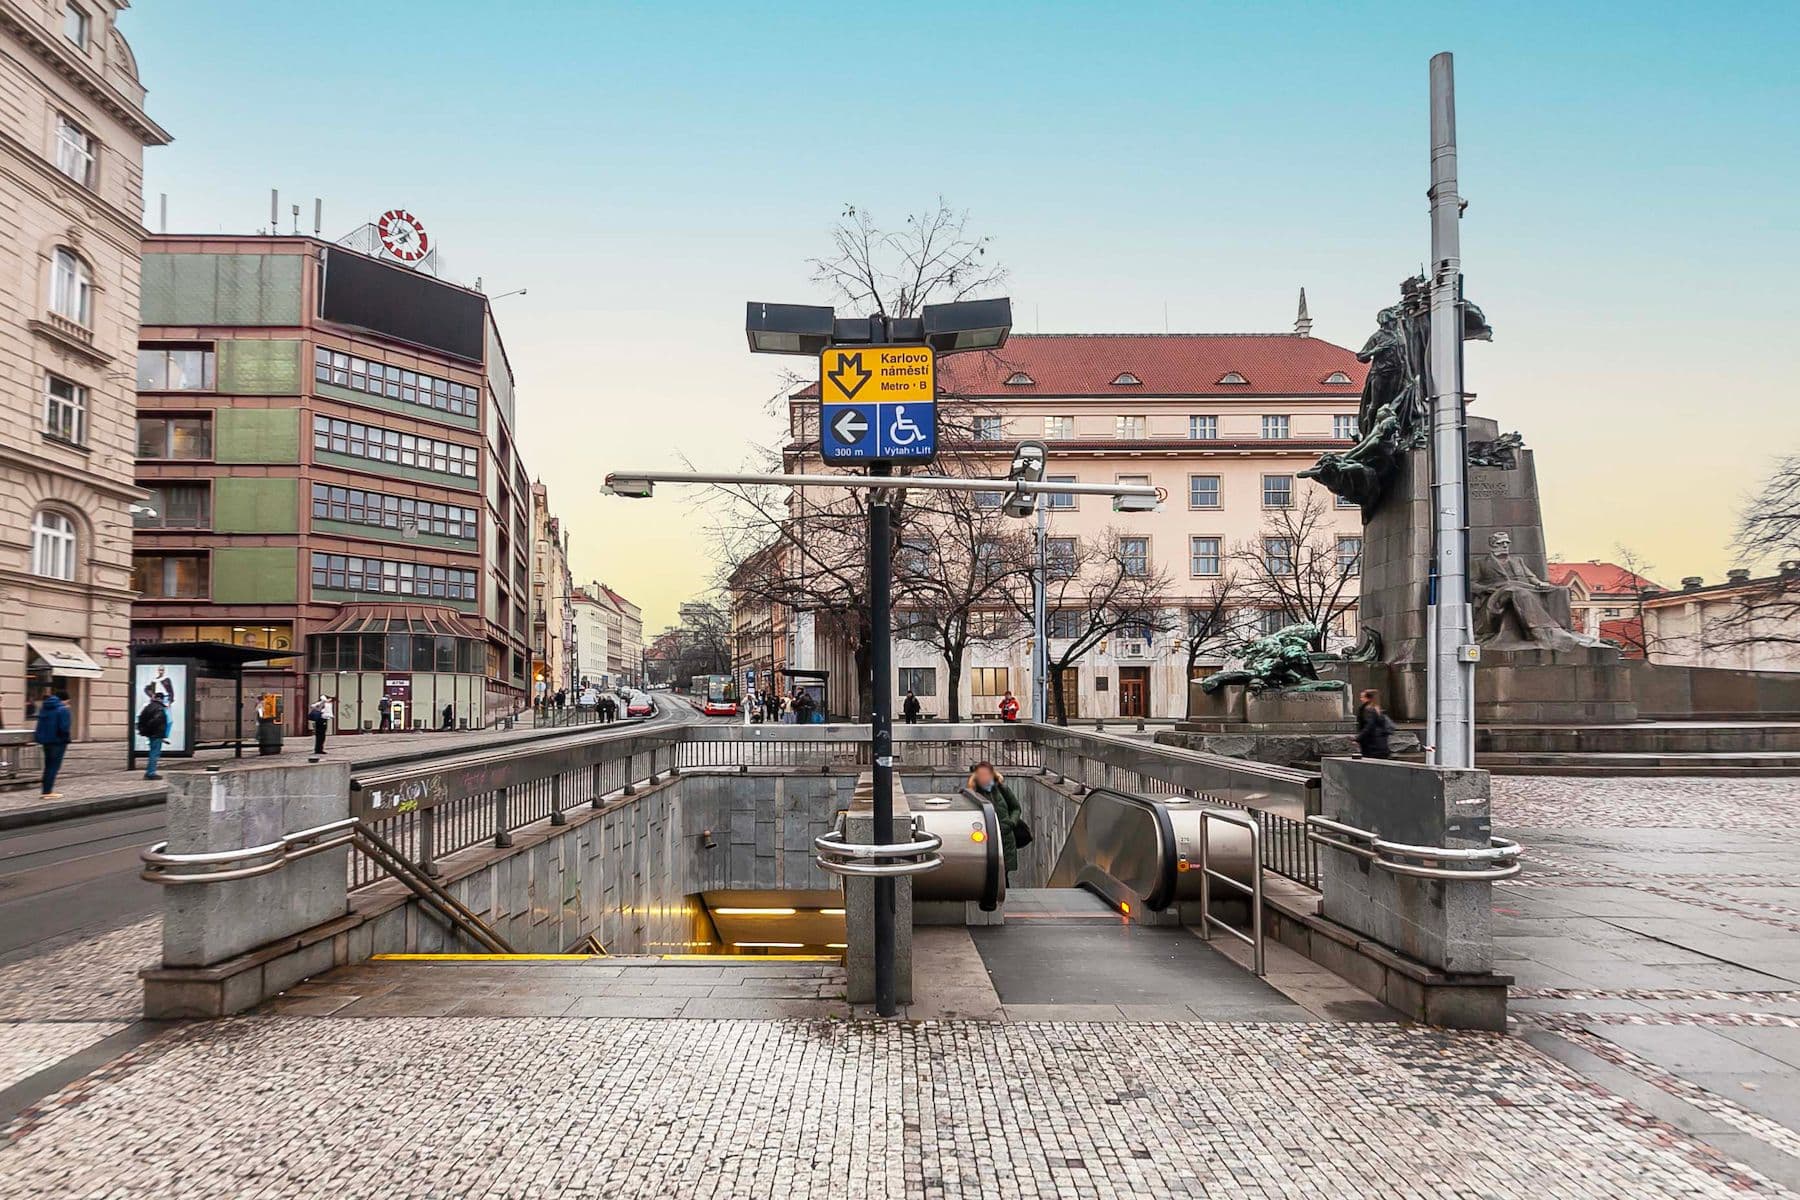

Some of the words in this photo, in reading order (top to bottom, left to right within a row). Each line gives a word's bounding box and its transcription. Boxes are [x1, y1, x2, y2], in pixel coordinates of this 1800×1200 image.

[880, 352, 929, 364] Karlovo
[880, 364, 929, 376] náměstí
[880, 382, 910, 391] Metro
[919, 380, 927, 390] B
[834, 447, 852, 457] 300
[916, 446, 931, 454] Lift
